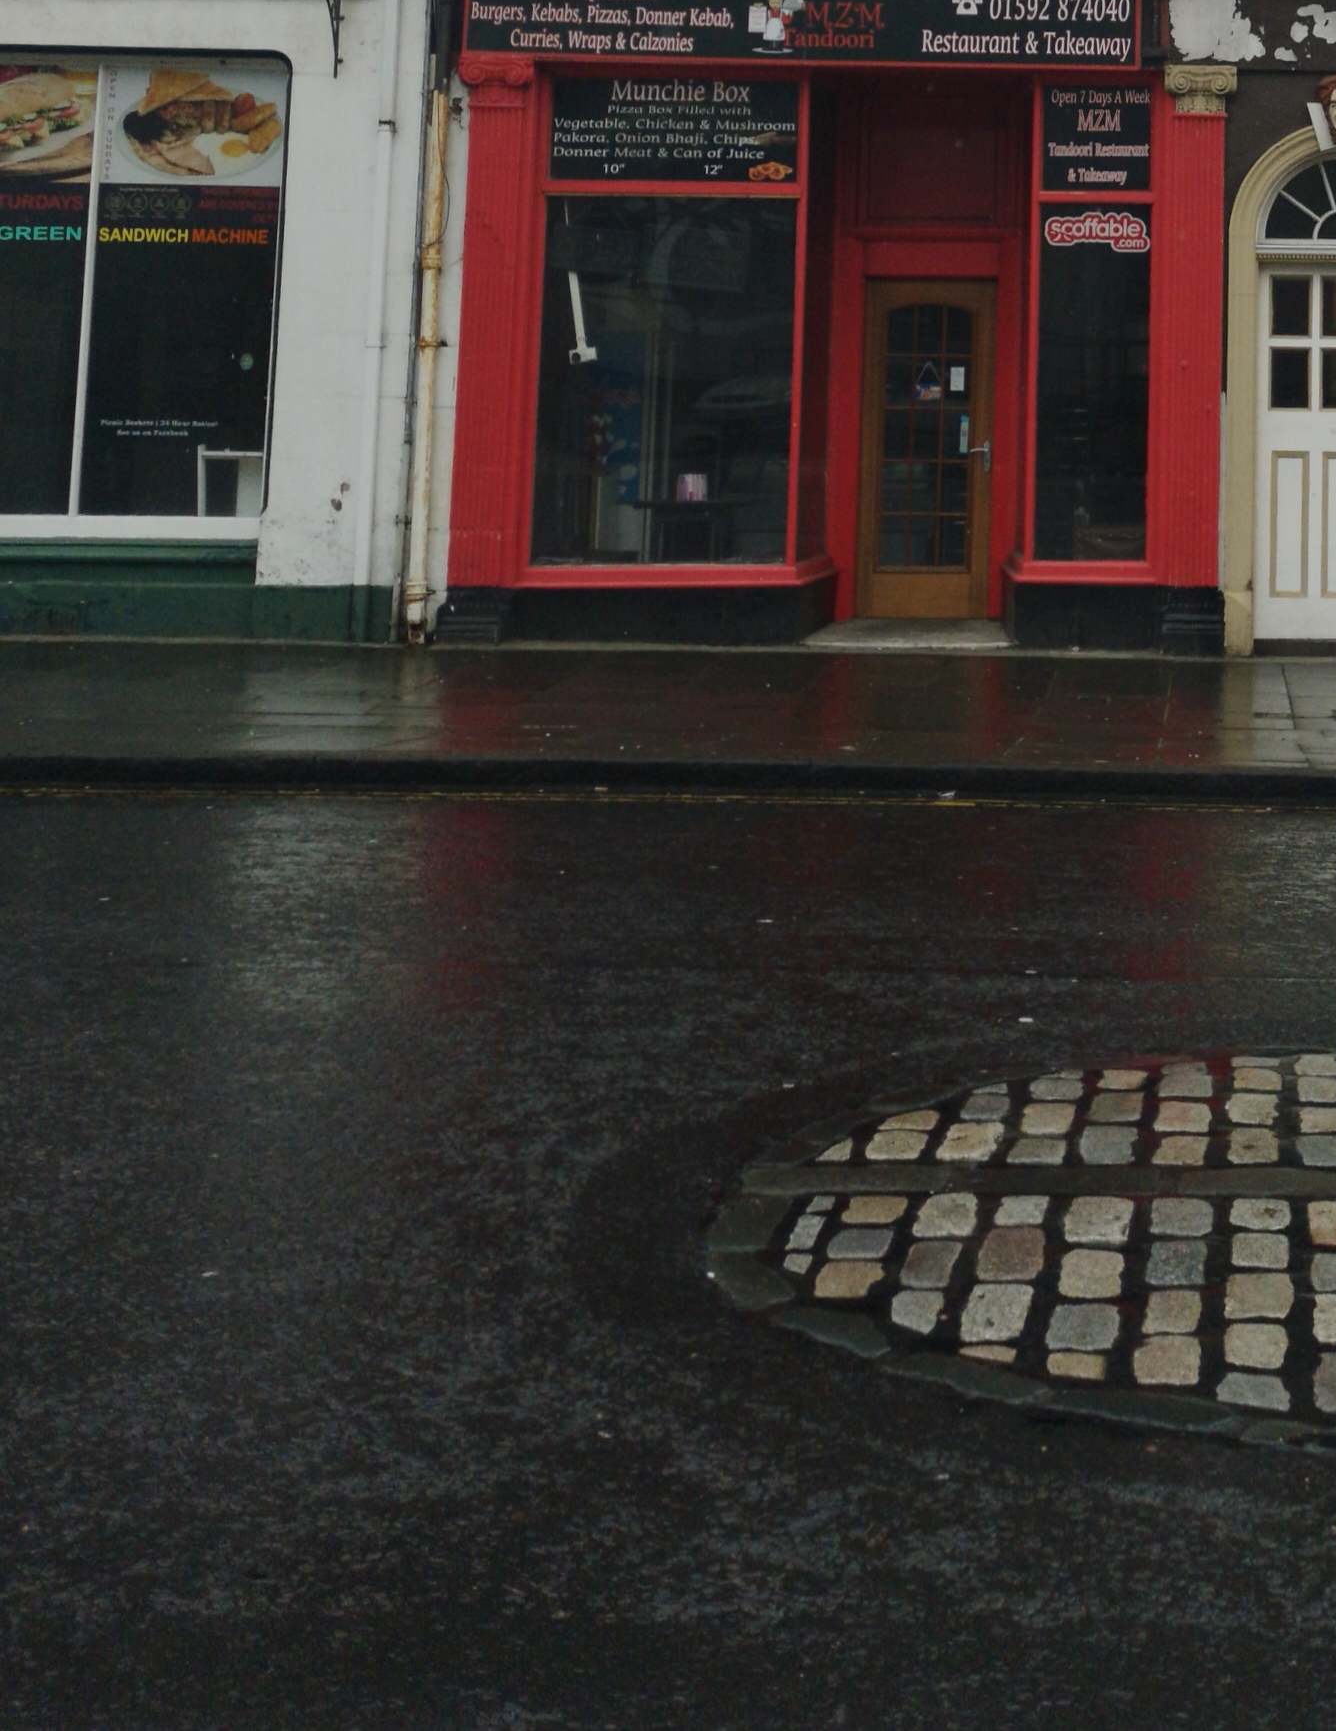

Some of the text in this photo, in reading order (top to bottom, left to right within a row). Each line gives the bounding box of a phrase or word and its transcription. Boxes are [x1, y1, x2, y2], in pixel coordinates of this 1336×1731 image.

[470, 1, 526, 25] Burgers,
[531, 3, 583, 25] Kebabs,
[587, 5, 632, 27] Pizzas,
[635, 7, 686, 26] Donner
[689, 7, 735, 30] Kebab,
[510, 28, 694, 54] Curries, Wraps & Calzonies
[784, 27, 875, 49] Tandoori
[921, 29, 1132, 62] Restaurant & Takeaway
[611, 80, 750, 103] Munchie Box
[1051, 89, 1150, 107] Open 7 Days A Week
[607, 104, 751, 116] Pizza Box Filled with
[635, 118, 694, 130] Chicken
[699, 119, 710, 130] &
[715, 119, 796, 131] Mushroom
[1077, 109, 1121, 131] MZM
[615, 133, 660, 144] Onion
[553, 146, 765, 160] Donner Meat & Can of Juice
[1048, 142, 1149, 157] Tandoori Restaurant
[1067, 167, 1127, 186] & Takeaway
[99, 228, 269, 244] SANDWICH MACHINE
[1051, 218, 1141, 241] scoffable
[1117, 239, 1144, 248] .com
